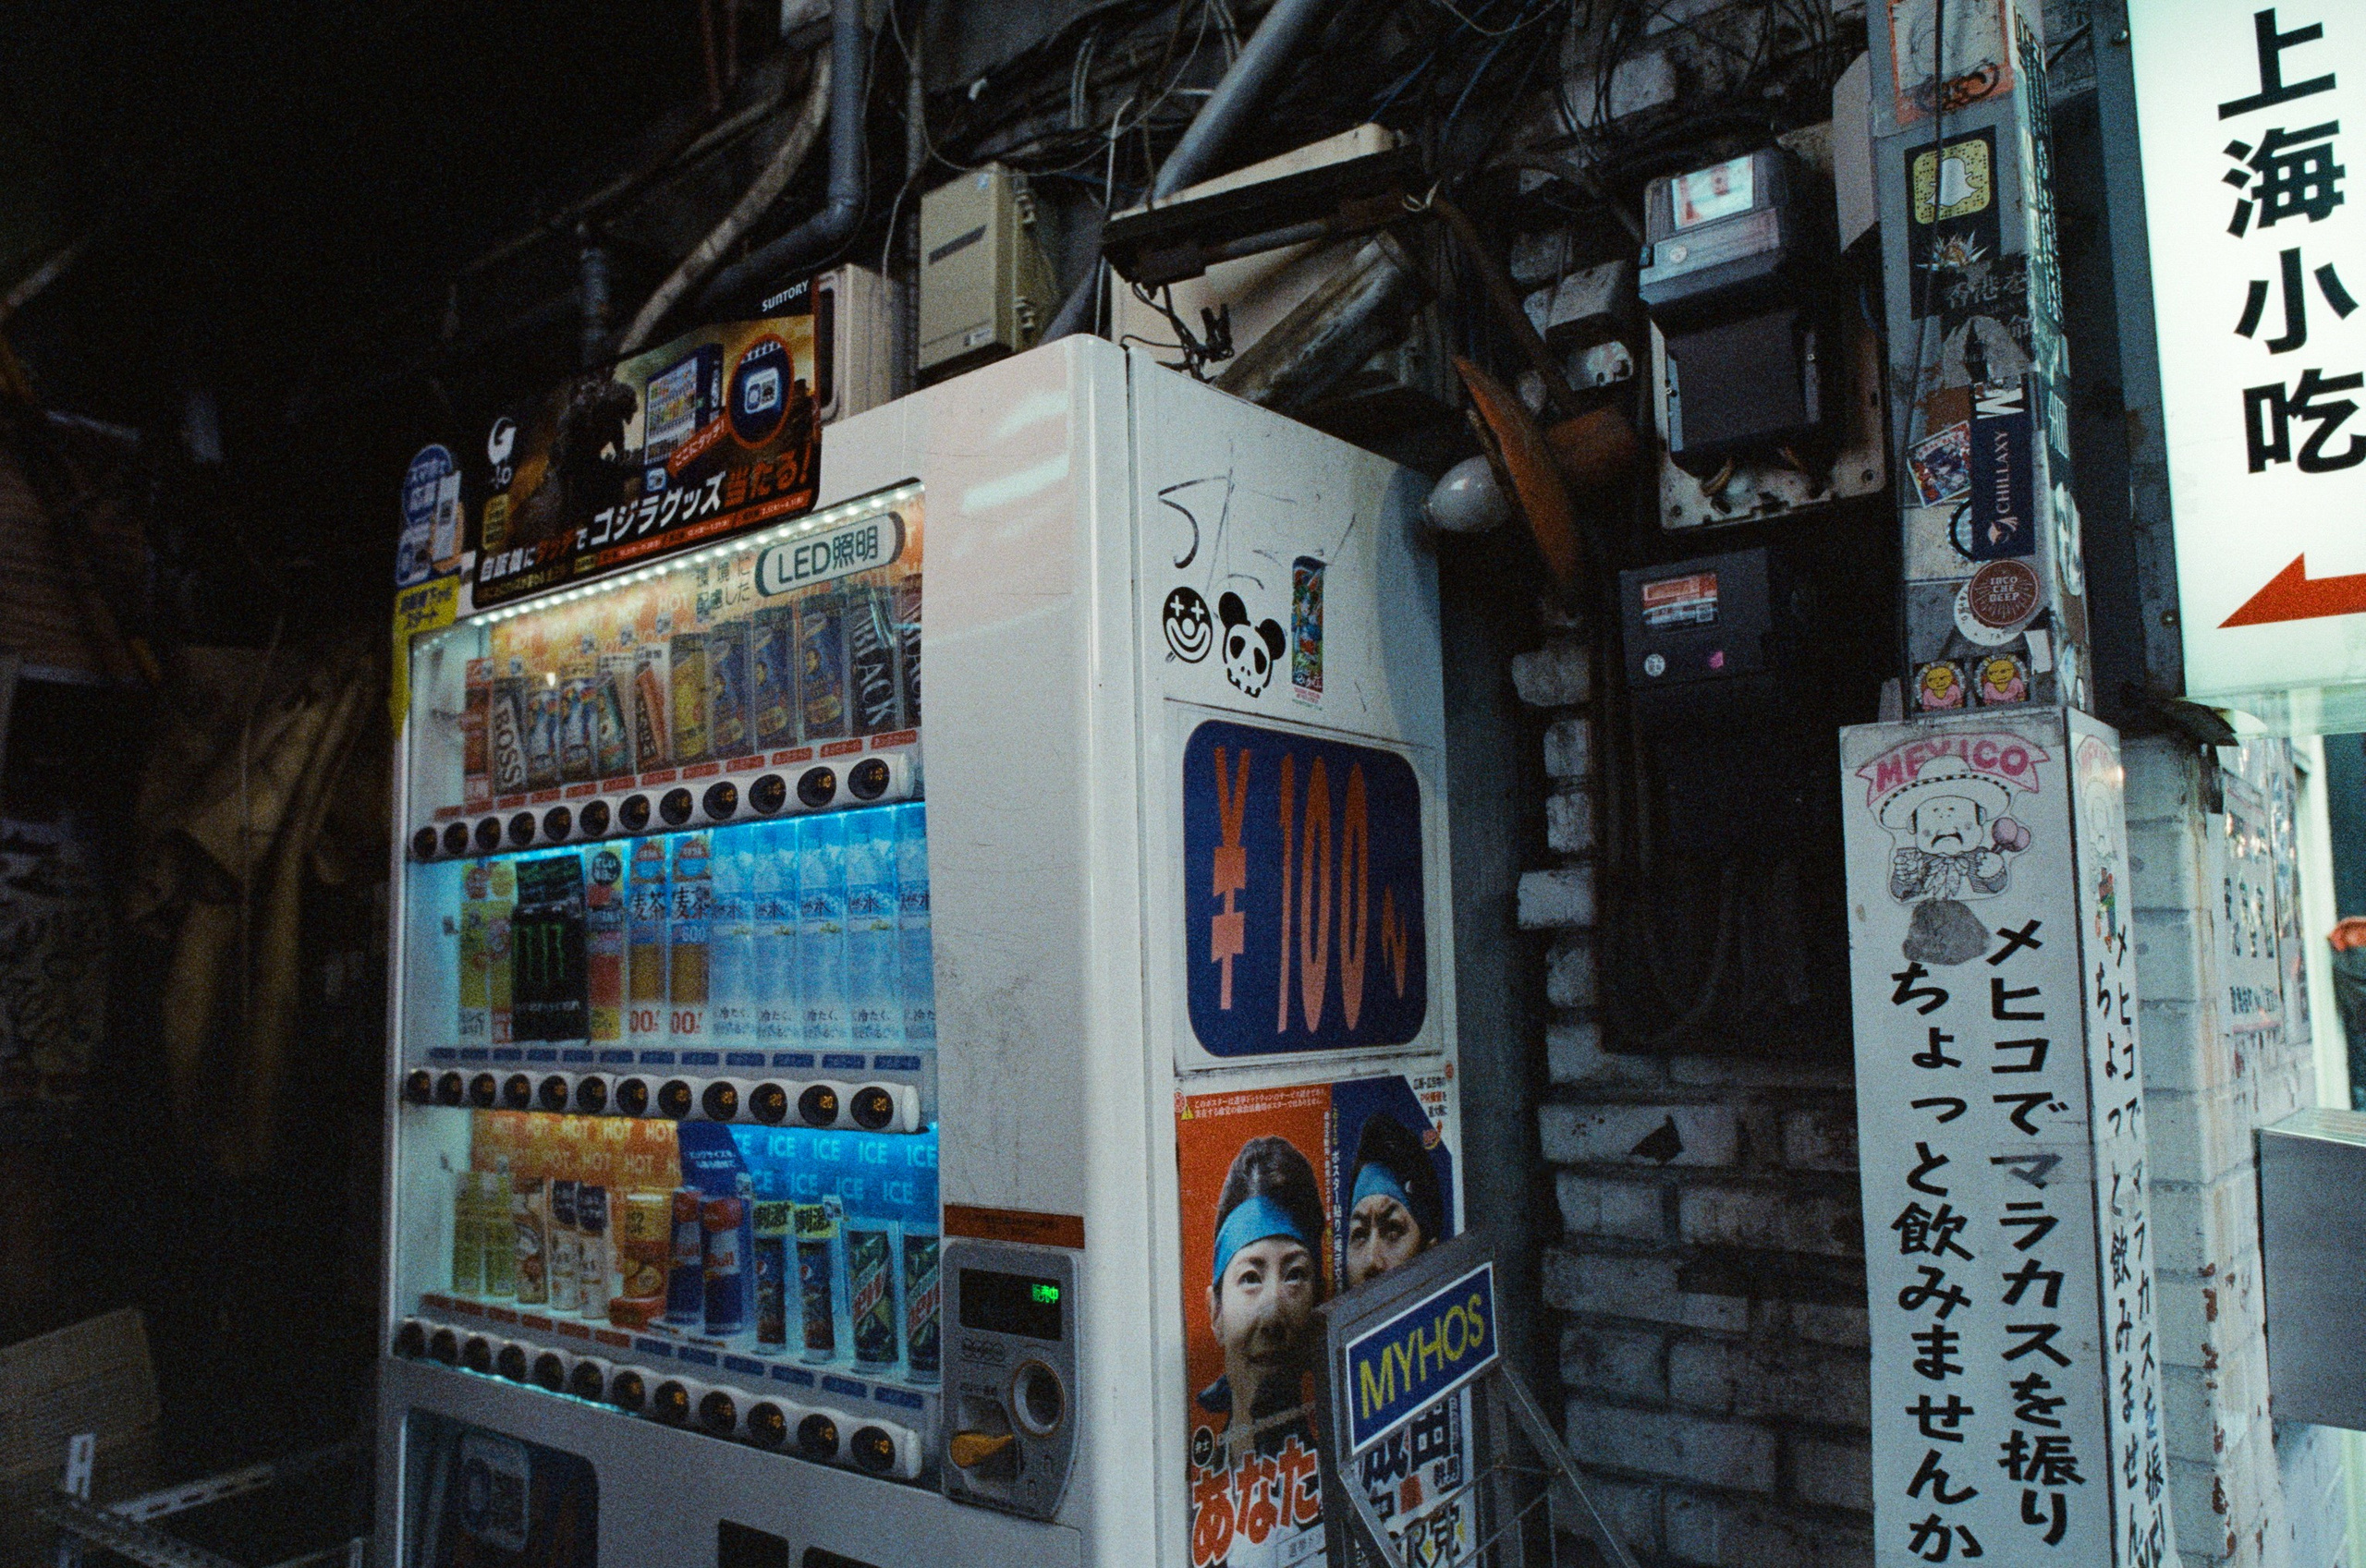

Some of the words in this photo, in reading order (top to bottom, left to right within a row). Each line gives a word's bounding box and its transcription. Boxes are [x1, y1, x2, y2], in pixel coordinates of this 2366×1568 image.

[2217, 6, 2366, 475] 上海小吃
[761, 279, 810, 312] SUNTORY
[1994, 431, 2011, 514] CHILLAXY
[777, 525, 879, 585] LED照明
[768, 1135, 796, 1157] ICE
[813, 1137, 841, 1162] ICE
[858, 1139, 888, 1164] ICE
[907, 1144, 937, 1168] ICE
[790, 1173, 818, 1196] ICE
[835, 1176, 864, 1200] ICE
[883, 1181, 914, 1205] ICE
[1890, 961, 1984, 1563] ちょっと飲みませんか
[1986, 919, 2087, 1547] メヒコでマラカスを振り
[1359, 1293, 1485, 1419] MYHOS
[1191, 1433, 1320, 1568] あなた
